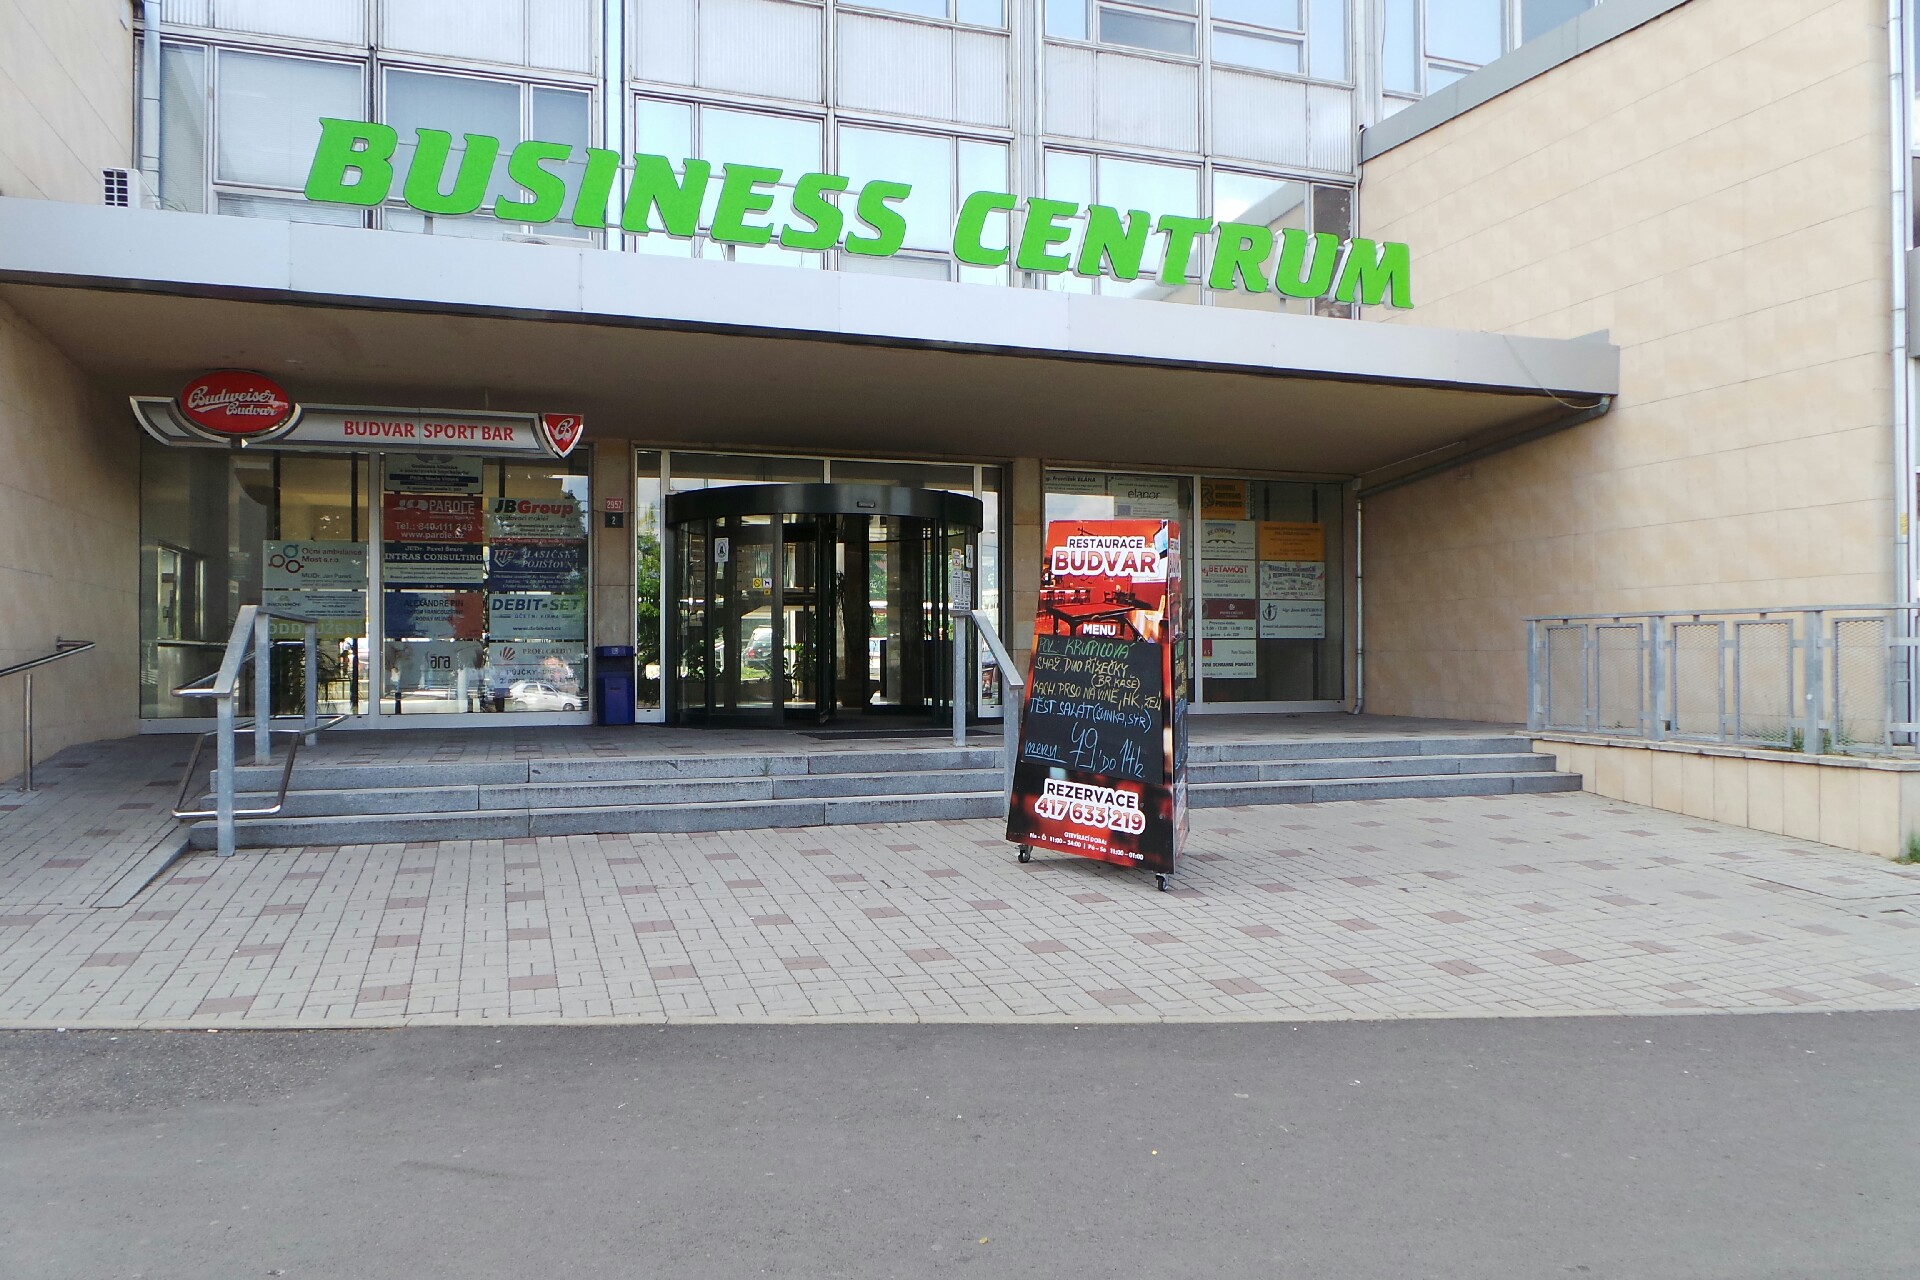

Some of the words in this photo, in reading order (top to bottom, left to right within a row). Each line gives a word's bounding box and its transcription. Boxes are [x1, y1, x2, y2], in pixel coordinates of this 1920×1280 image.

[305, 118, 911, 256] BUSINESS
[954, 192, 1412, 308] CENTRUM
[188, 386, 277, 408] Budweiser
[226, 401, 277, 416] Budvar
[344, 420, 415, 438] BUDVAR
[423, 423, 477, 440] SPORT
[481, 426, 514, 441] BAR
[429, 500, 475, 515] PAROLE
[494, 499, 574, 518] JBGroup
[606, 500, 622, 509] 2957
[611, 516, 616, 525] 2
[1068, 538, 1144, 549] RESTAURACE
[384, 552, 421, 560] INTRAS
[423, 553, 483, 561] CONSULTING
[1055, 550, 1156, 573] BUDVAR
[491, 598, 581, 611] DEBIT-SET
[1082, 623, 1117, 636] MENU
[1046, 782, 1136, 808] REZERVACE
[1037, 797, 1068, 817] 417
[1072, 803, 1106, 824] 633
[1111, 809, 1143, 831] 219
